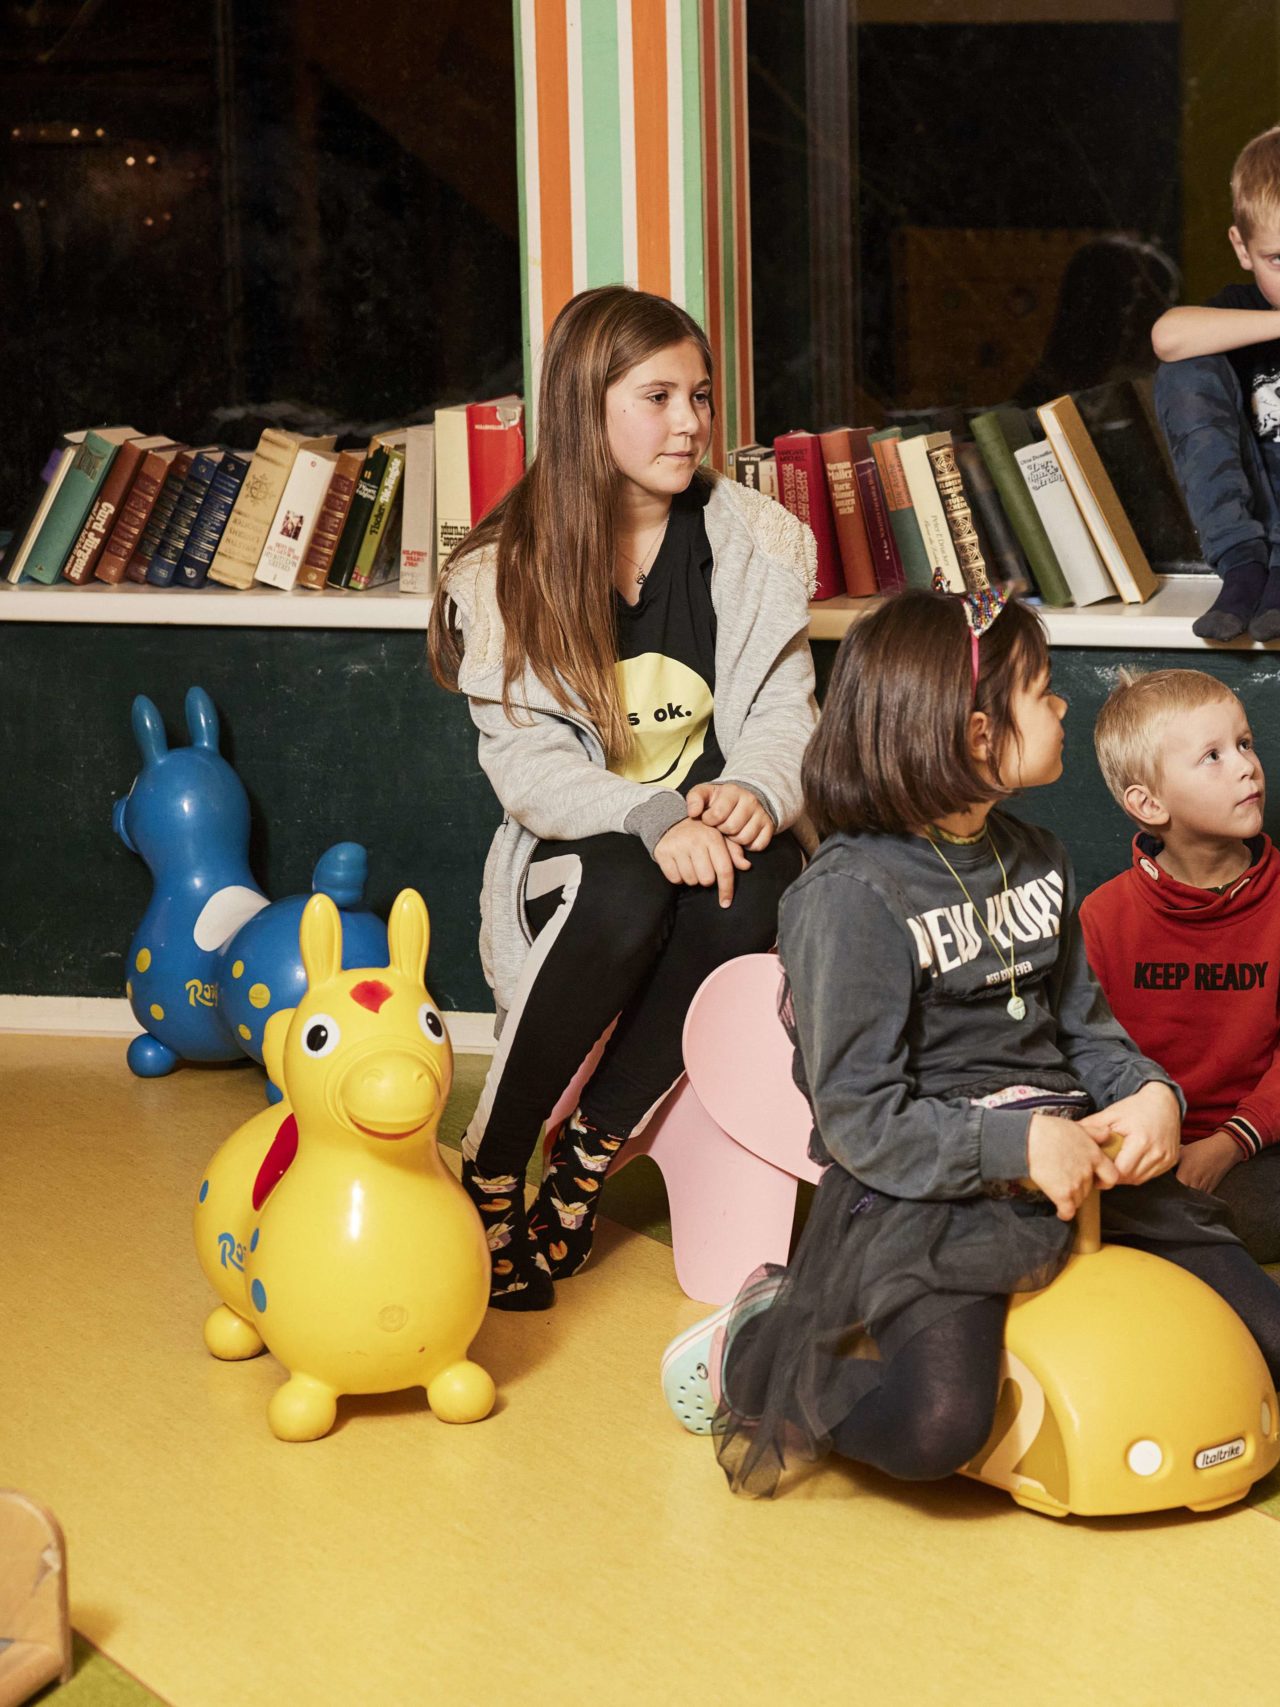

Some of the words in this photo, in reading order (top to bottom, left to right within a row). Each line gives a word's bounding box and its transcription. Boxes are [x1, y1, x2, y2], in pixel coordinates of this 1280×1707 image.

[828, 468, 854, 481] Mailer
[91, 501, 116, 534] Curd
[69, 531, 101, 580] Jürgens
[627, 712, 641, 726] s
[653, 702, 692, 723] ok.
[906, 902, 983, 978] NEW
[1014, 960, 1034, 976] EVER
[1134, 962, 1190, 990] KEEP
[1194, 961, 1268, 991] READY
